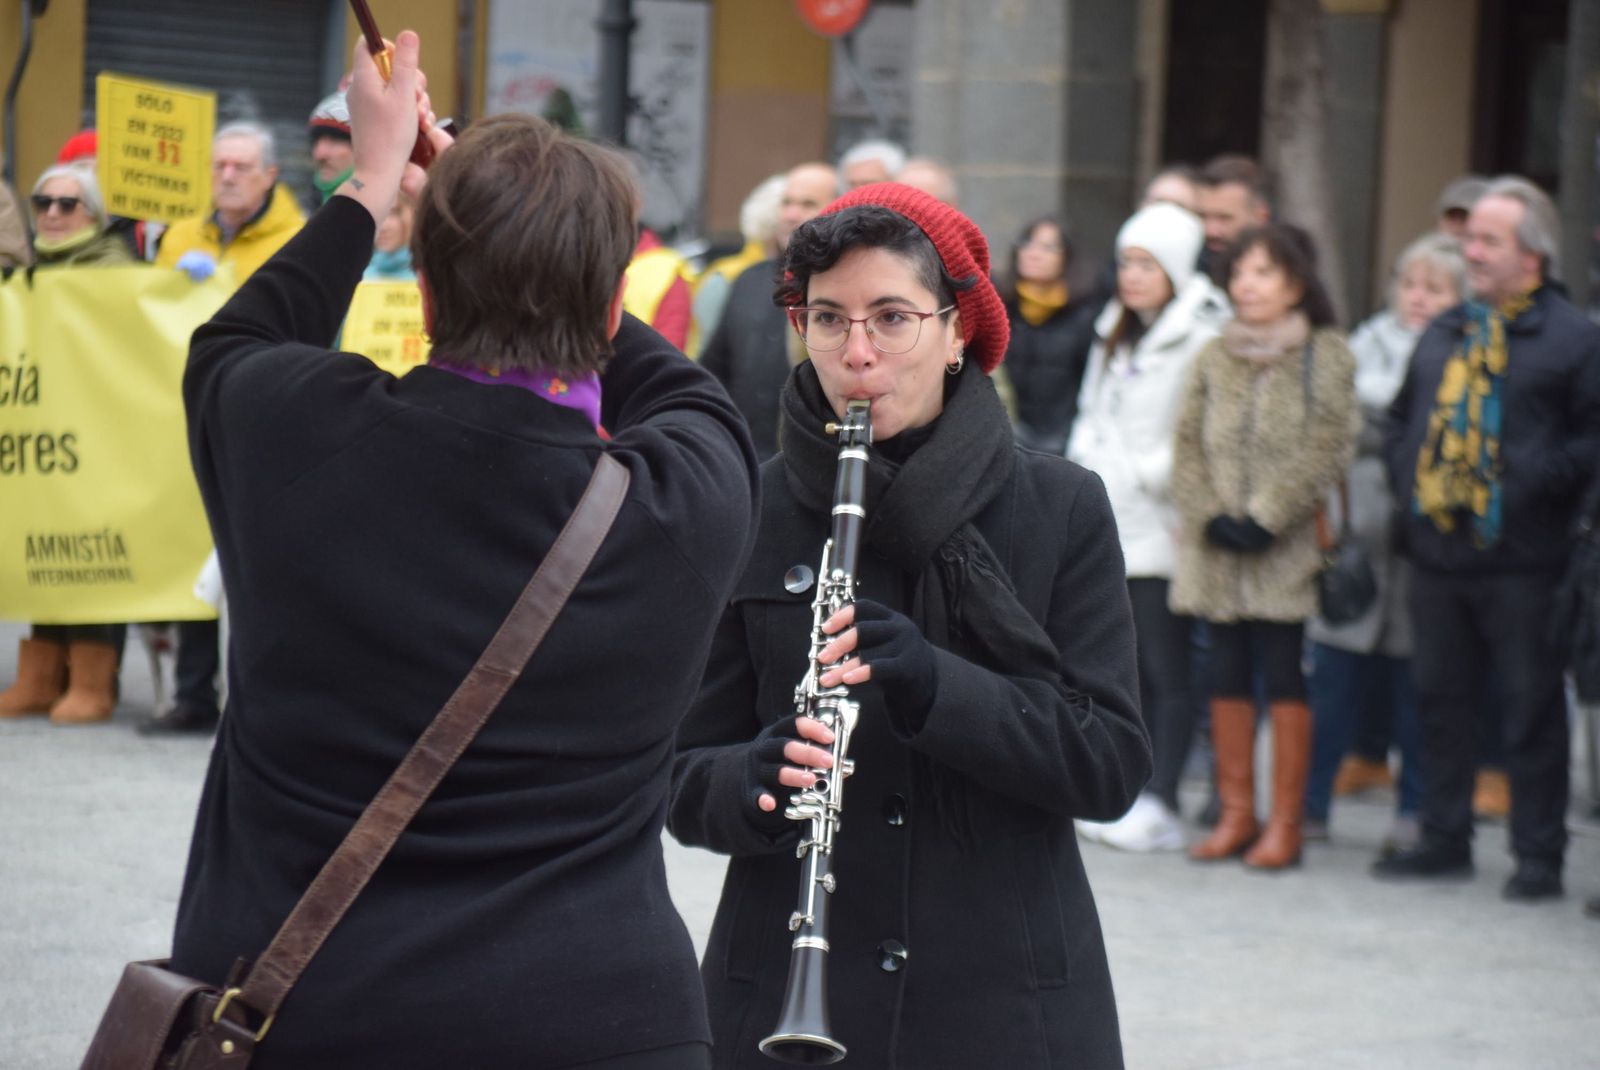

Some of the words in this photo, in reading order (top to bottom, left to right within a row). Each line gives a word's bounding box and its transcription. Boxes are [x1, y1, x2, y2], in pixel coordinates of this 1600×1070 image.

[127, 119, 146, 134] EN
[123, 143, 150, 161] VAN
[26, 526, 128, 562] AMNISTÍA
[28, 567, 134, 587] INTERNACIONAL
